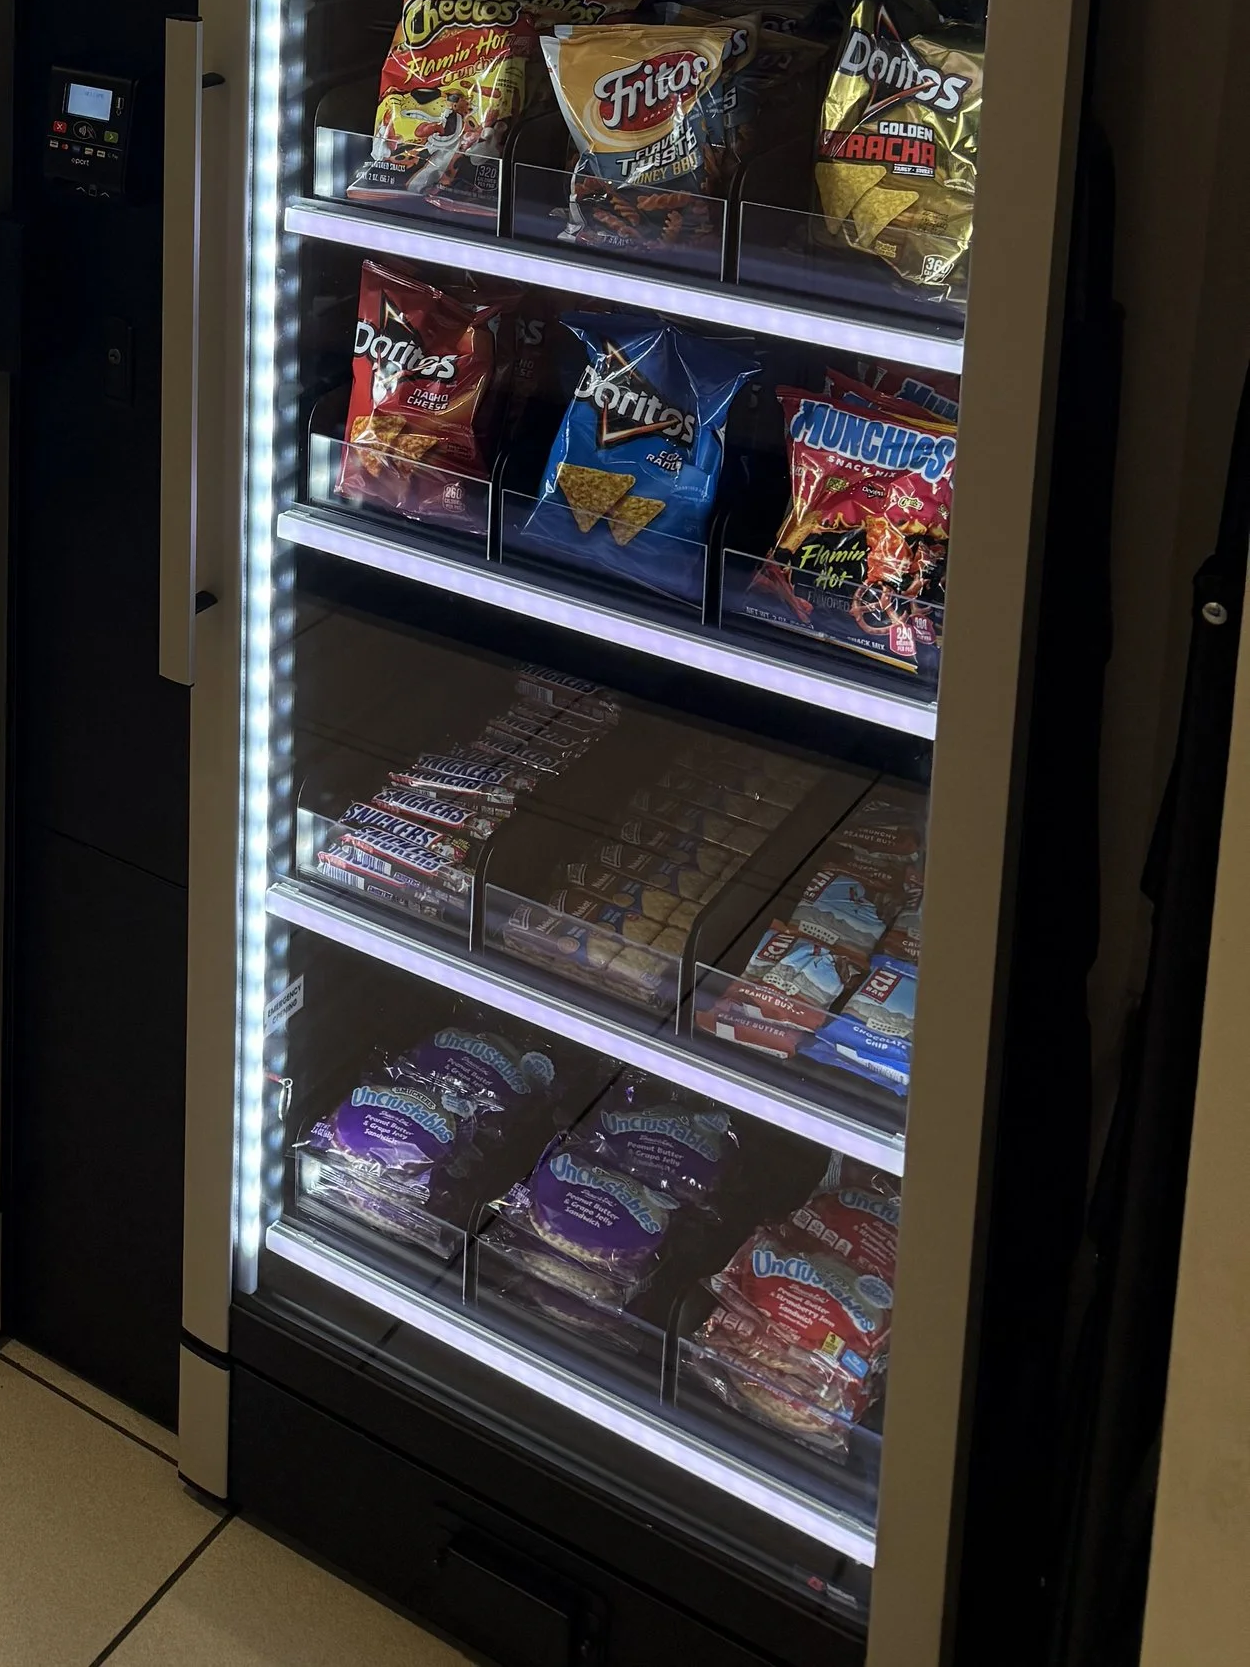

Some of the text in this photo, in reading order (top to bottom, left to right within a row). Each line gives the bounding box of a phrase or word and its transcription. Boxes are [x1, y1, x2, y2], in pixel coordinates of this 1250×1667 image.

[405, 28, 510, 86] Flamin' Hot
[839, 29, 973, 111] Doritos
[593, 56, 709, 129] Fritos
[879, 120, 933, 141] GOLDEN
[478, 164, 497, 179] 320
[353, 320, 459, 381] Doritos
[406, 395, 449, 412] CHEESE
[412, 387, 450, 404] NACHO
[573, 363, 697, 445] Doritos
[790, 399, 958, 483] MUNCHIES
[827, 455, 897, 479] SNACK MIX
[800, 540, 870, 570] Flamin'
[814, 567, 854, 590] Hot
[346, 803, 432, 846] SNICKERS
[852, 1025, 908, 1050] CHOCOLATE
[865, 1037, 888, 1051] CHIP
[433, 1030, 531, 1095] Uncrustables
[351, 1085, 454, 1144] Uncrustables
[601, 1110, 719, 1163] Uncrustables
[549, 1153, 661, 1235] Uncrustables
